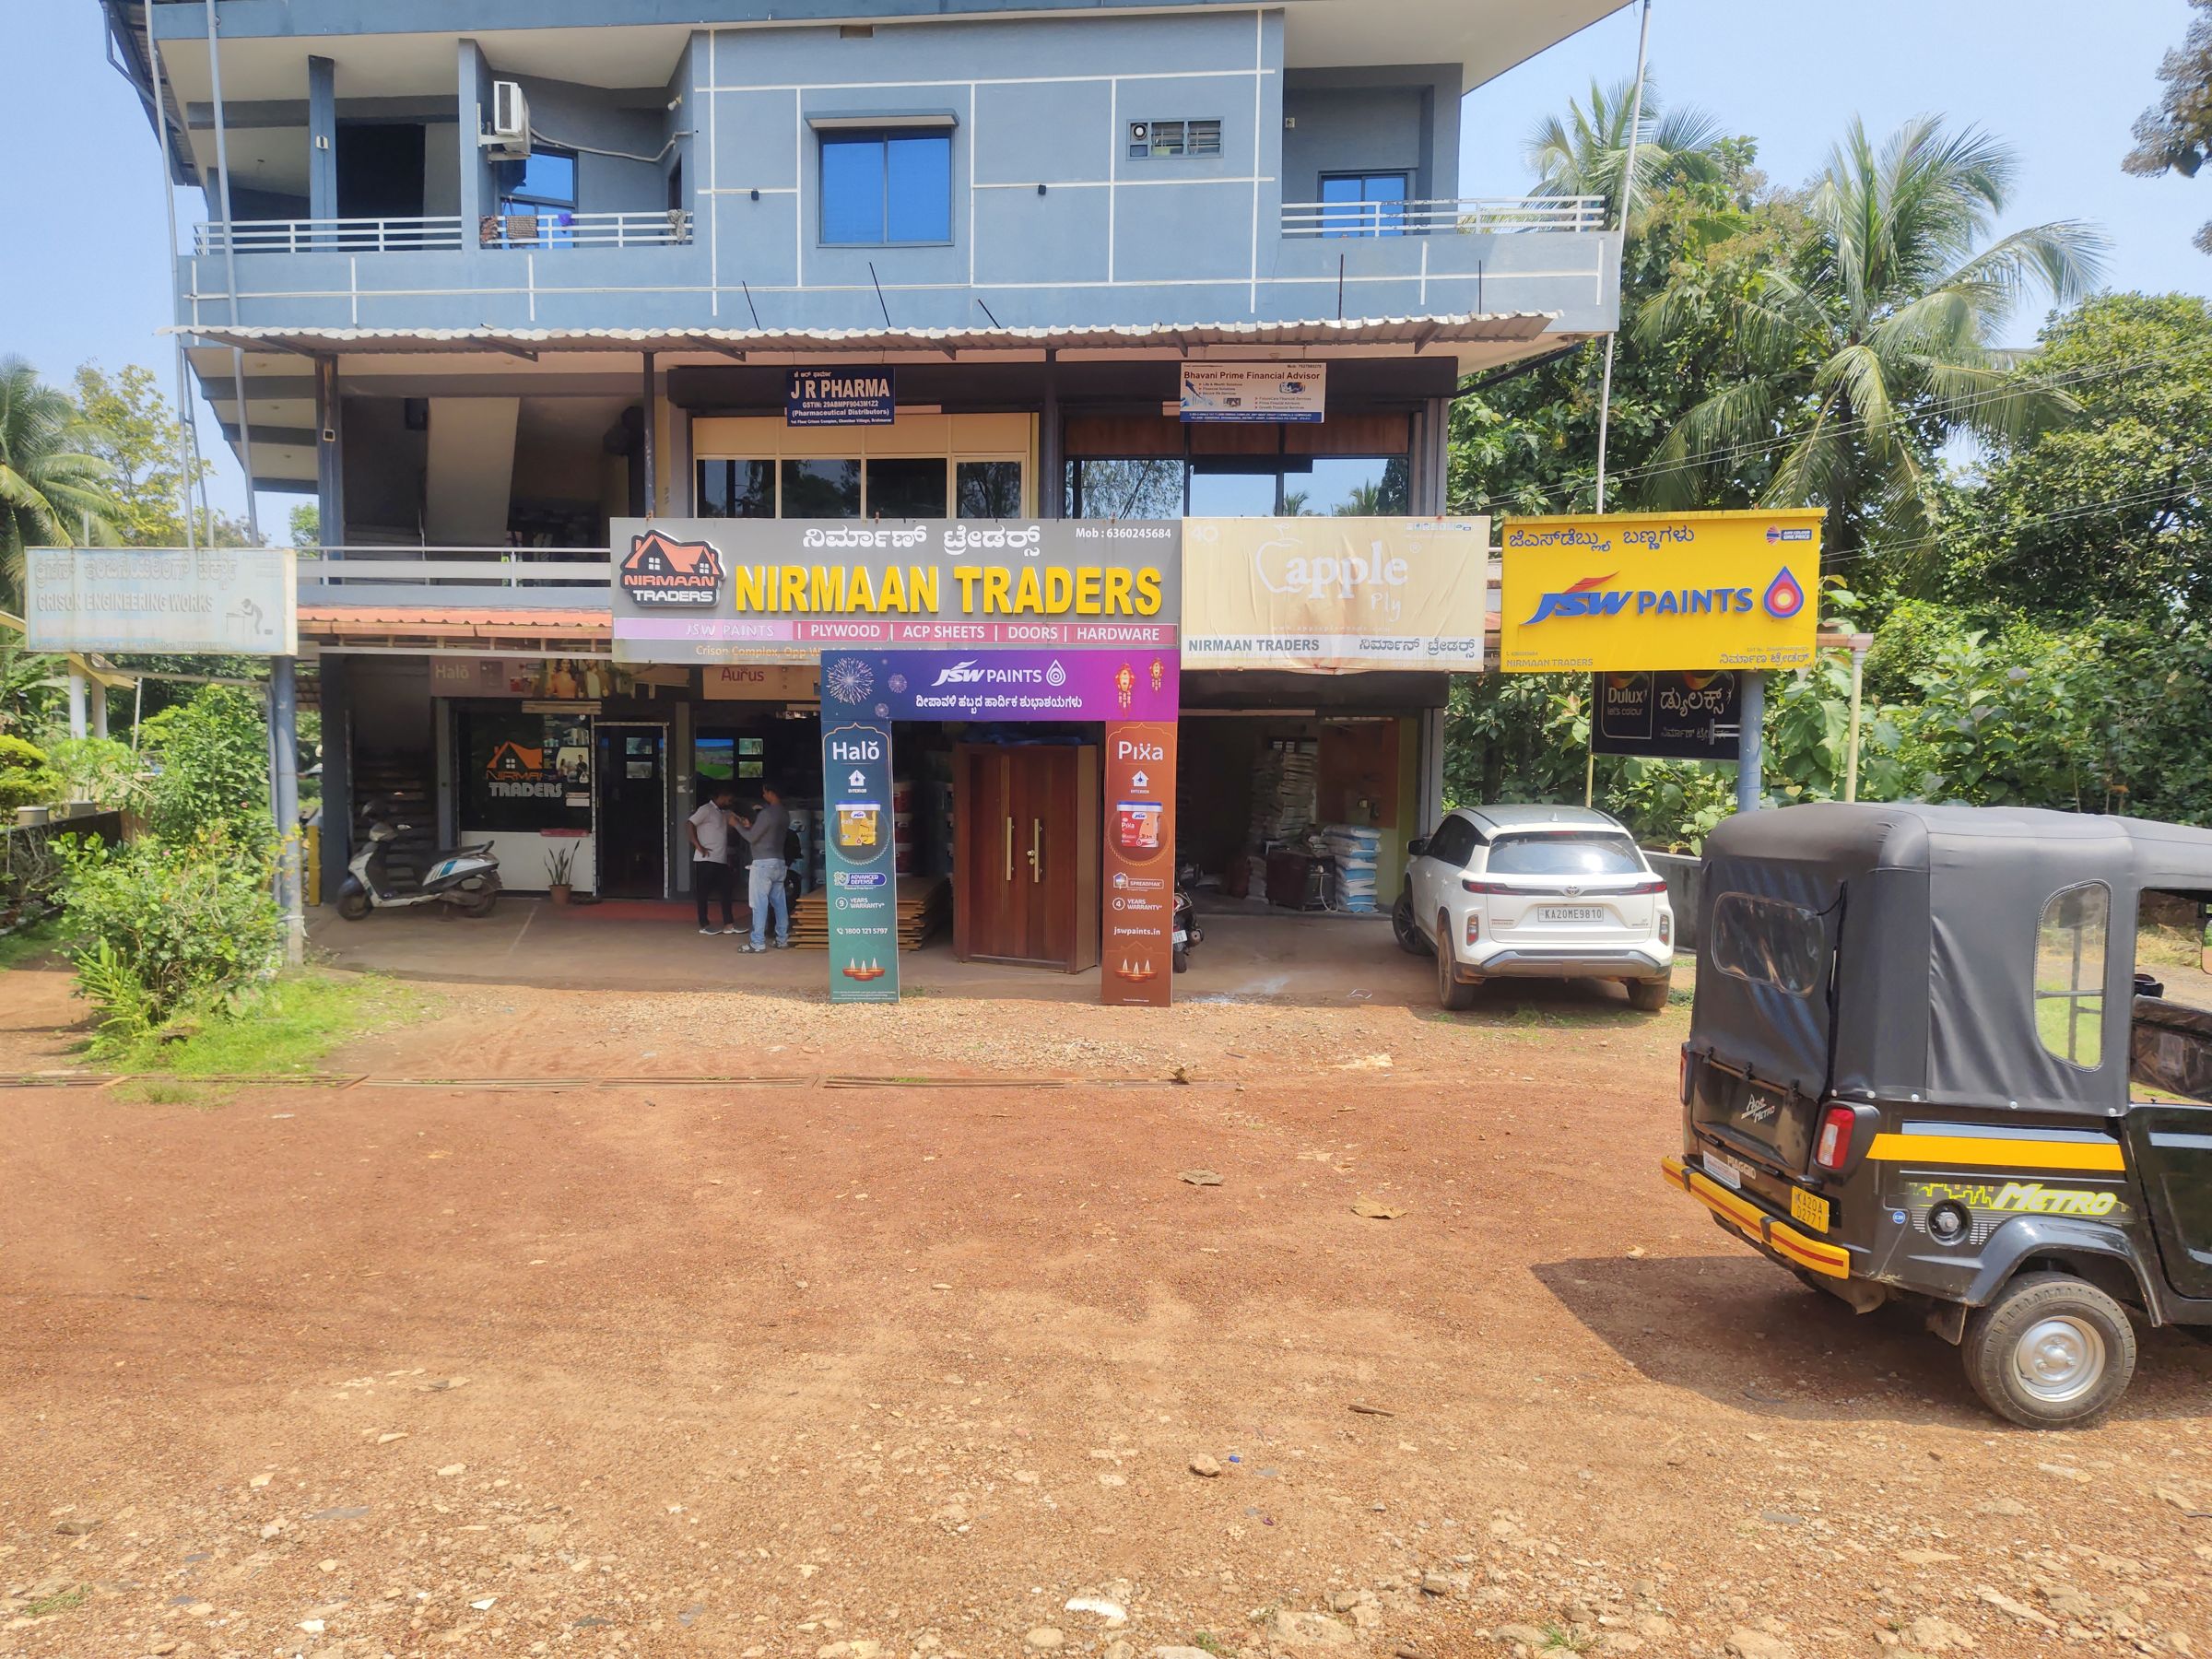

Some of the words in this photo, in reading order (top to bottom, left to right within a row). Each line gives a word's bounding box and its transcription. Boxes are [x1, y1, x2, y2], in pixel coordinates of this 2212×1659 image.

[1183, 371, 1218, 380] Bhavani
[1219, 371, 1244, 380] Prime
[1246, 371, 1285, 380] Financial
[1287, 371, 1321, 380] Advisor
[790, 380, 800, 399] J
[805, 380, 817, 399] R
[820, 378, 890, 398] PHARMA
[792, 409, 846, 418] (Pharmaceutical
[848, 407, 889, 416] Distributors)
[1076, 527, 1099, 539] Mob
[1106, 528, 1171, 539] 6360245684
[1622, 524, 1695, 550] ಬಣ್ಣಗಳು
[1285, 540, 1408, 599] apple
[624, 574, 715, 588] NIRMAAN
[632, 590, 713, 603] TRADERS
[735, 565, 939, 614] NIRMAAN
[952, 566, 1163, 616] TRADERS
[85, 593, 167, 612] ENGINEERING
[169, 593, 213, 612] WORKS
[1371, 592, 1402, 623] Ply
[1519, 590, 1633, 626] JSW
[1637, 587, 1754, 615] PAINTS
[685, 622, 716, 636] JSW
[723, 623, 774, 637] PAINTS
[810, 624, 881, 638] PLYWOOD
[902, 625, 931, 639] ACP
[934, 625, 985, 639] SHEETS
[1007, 626, 1058, 640] DOORS
[1077, 627, 1160, 641] HARDWARE
[695, 645, 729, 655] Crison
[1188, 639, 1253, 652] NIRMAAN
[1256, 639, 1320, 652] TRADERS
[1507, 659, 1550, 667] NIRMAAN
[1552, 658, 1594, 666] TRADERS
[931, 667, 985, 687] JSW
[986, 669, 1042, 683] PAINTS
[1607, 688, 1643, 704] Dulux
[915, 694, 957, 708] ದೀಪಾವಳಿ
[958, 695, 982, 714] ಹಬ್ಬದ
[984, 694, 1018, 708] ಹಾರ್ದಿಕ
[1019, 695, 1083, 710] ಶುಭಾಶಯಗಳು
[1621, 707, 1643, 716] colour
[488, 782, 562, 798] TRADERS
[1545, 909, 1602, 920] KA20ME9810
[1113, 926, 1160, 935] jswpaints.in
[1726, 1155, 1757, 1180] PIAGGIO
